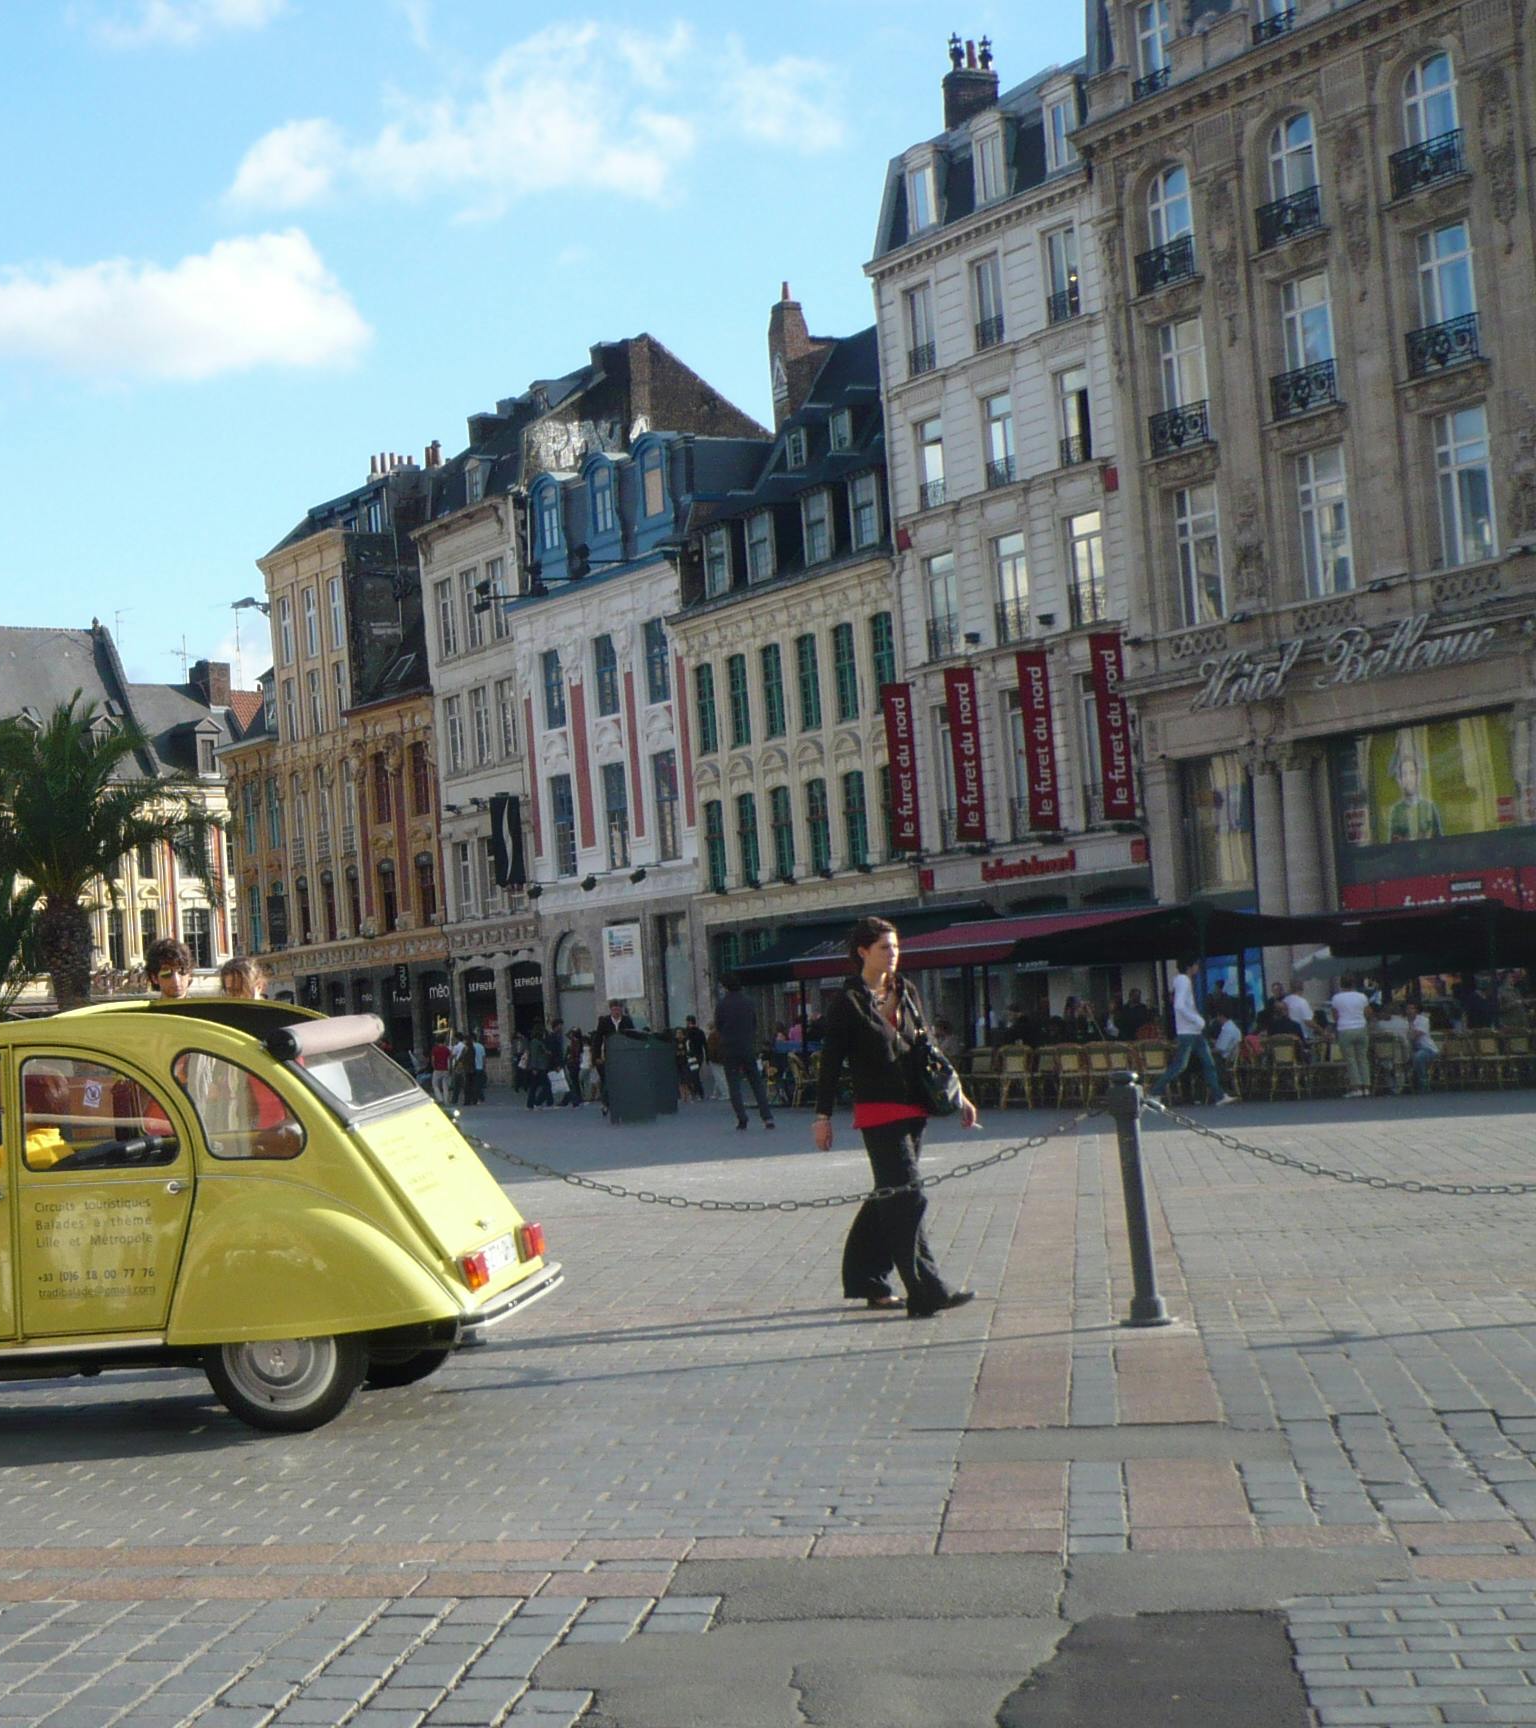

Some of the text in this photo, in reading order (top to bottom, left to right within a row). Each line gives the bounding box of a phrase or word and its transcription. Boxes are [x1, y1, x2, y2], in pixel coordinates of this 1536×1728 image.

[1313, 614, 1496, 688] Bellevue
[1107, 702, 1121, 727] du
[1026, 666, 1053, 816] le furet du nord
[891, 697, 914, 837] le furet du nord
[954, 683, 980, 827] le furet du nord
[1109, 732, 1125, 783] furet
[1112, 787, 1128, 804] le
[34, 1198, 152, 1213] Circuits touristiques
[35, 1219, 84, 1231] Balades
[36, 1236, 60, 1248] Lille
[70, 1236, 81, 1247] et
[104, 1269, 117, 1280] 00
[123, 1268, 135, 1278] 77
[143, 1267, 155, 1278] 76
